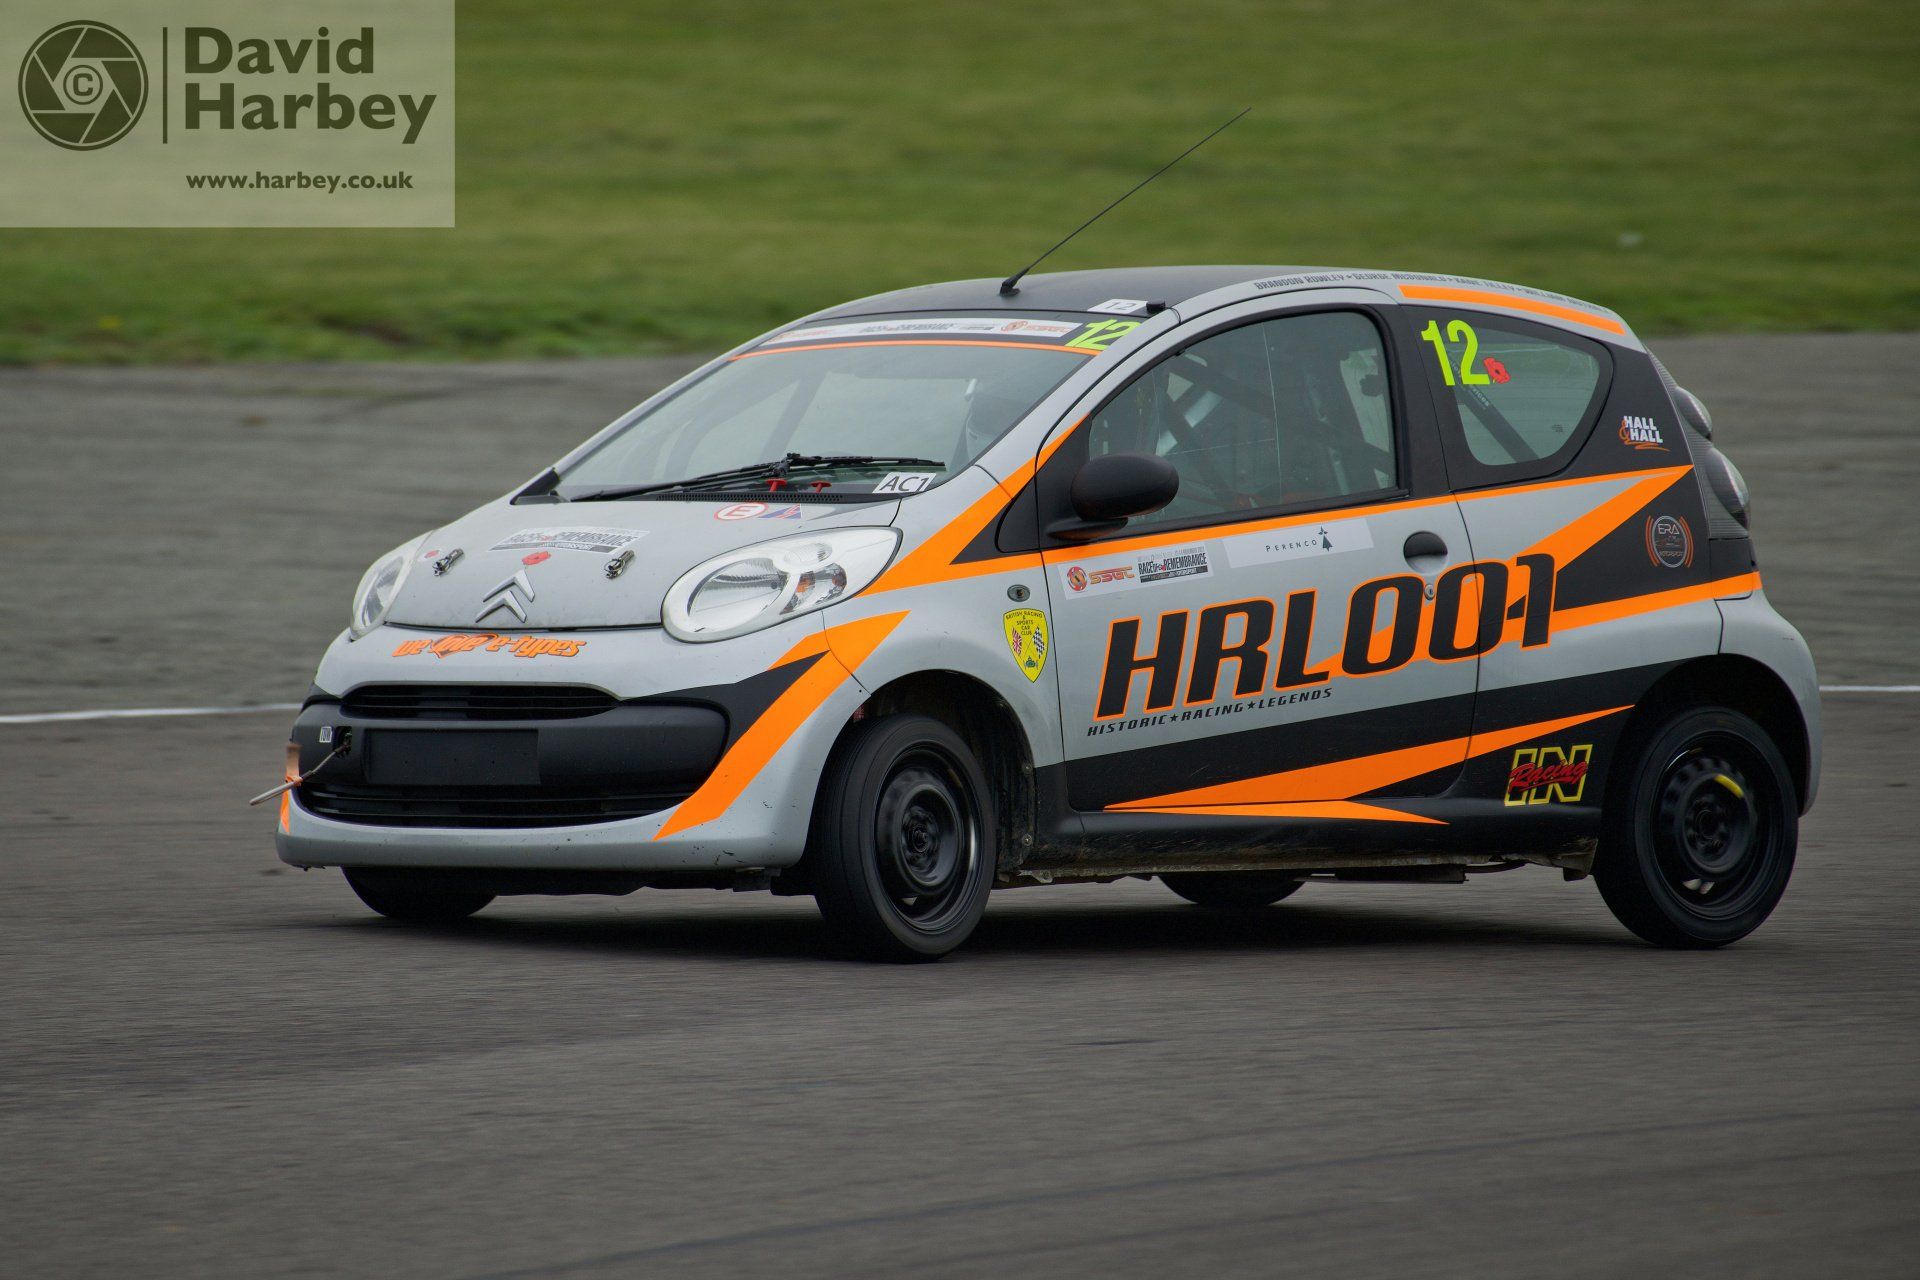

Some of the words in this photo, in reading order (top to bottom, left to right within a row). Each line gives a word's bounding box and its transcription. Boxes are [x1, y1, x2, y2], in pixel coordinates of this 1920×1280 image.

[1254, 276, 1304, 289] BRANDON
[1305, 273, 1344, 283] ROWLEY
[1353, 272, 1391, 281] GEORGE
[1105, 301, 1135, 311] 12
[1064, 319, 1141, 350] 12
[1421, 319, 1490, 386] 12
[1624, 416, 1657, 430] HALL
[1630, 428, 1663, 443] HALL
[879, 475, 929, 492] AC1
[1658, 524, 1680, 534] ERA
[1266, 539, 1317, 552] PERENCO
[1138, 561, 1154, 575] RACE
[1163, 553, 1207, 571] REMEMBRANCE
[1006, 611, 1022, 620] BRITISH
[1093, 553, 1557, 722] HRL001
[485, 635, 587, 658] e-types
[1087, 714, 1167, 737] HISTORIC
[1181, 702, 1243, 722] RACING
[1258, 687, 1333, 709] LEGENDS
[1508, 760, 1588, 793] Racing
